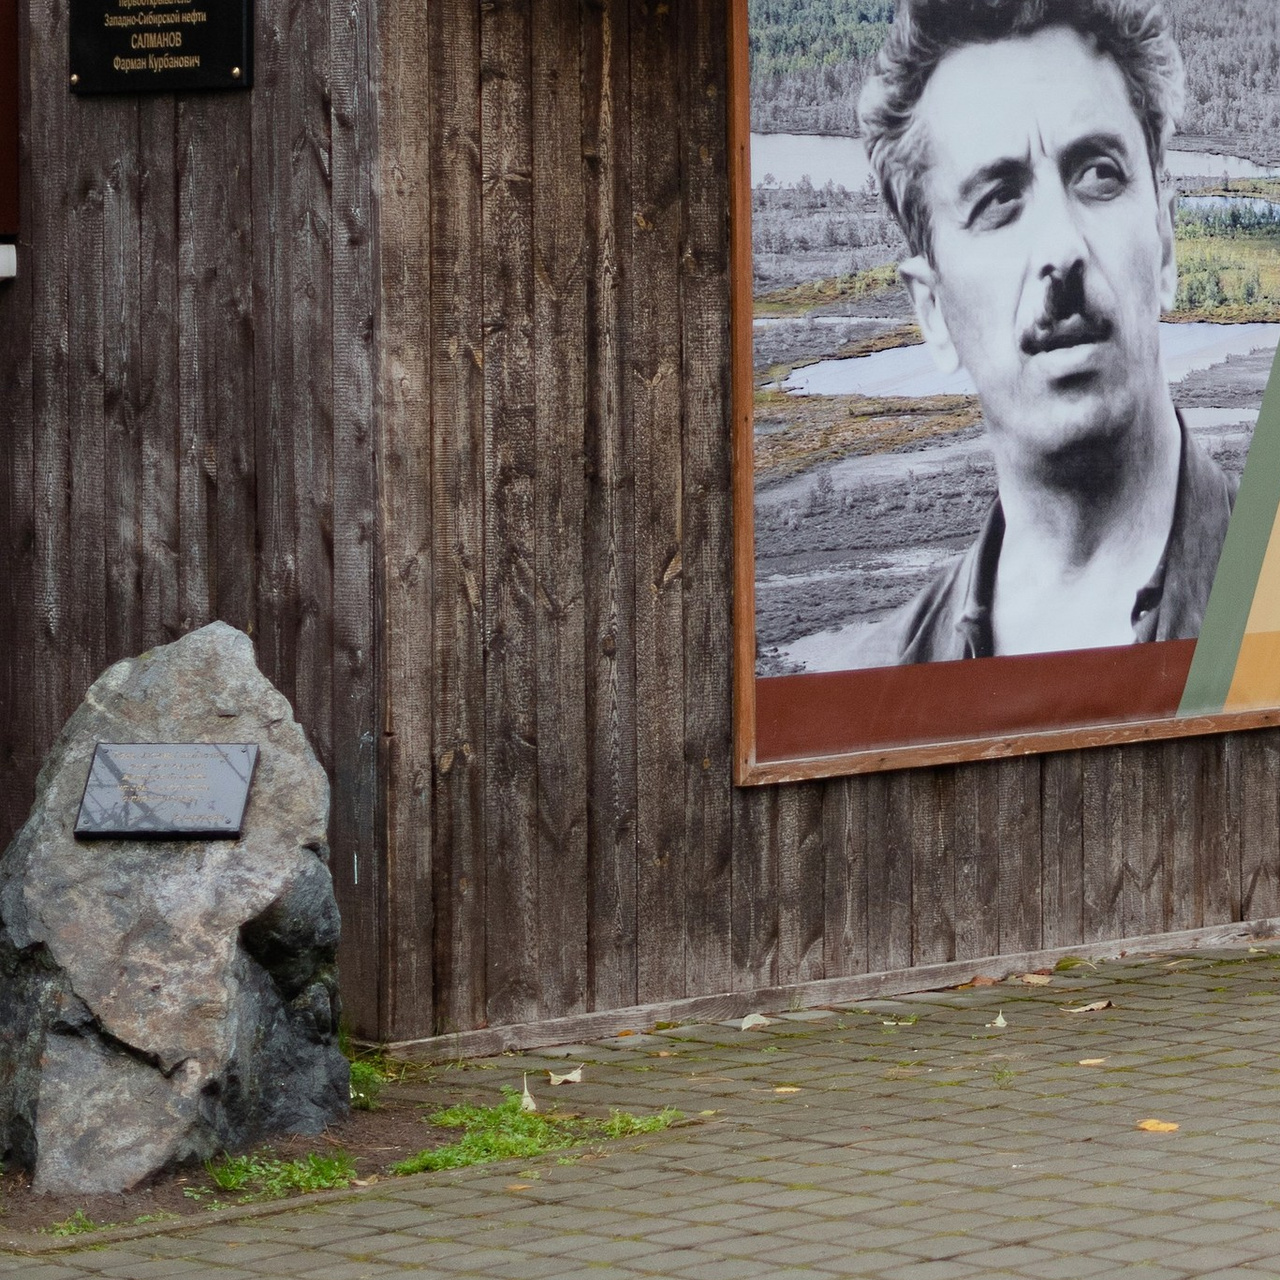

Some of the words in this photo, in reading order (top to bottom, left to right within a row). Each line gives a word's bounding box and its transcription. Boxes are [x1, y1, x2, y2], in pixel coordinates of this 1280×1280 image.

[104, 10, 180, 27] Западно-Сибирской
[182, 9, 206, 25] нефти
[131, 32, 181, 49] САЛМАНОВ
[113, 56, 146, 73] Фарман
[149, 53, 200, 72] Курбанович
